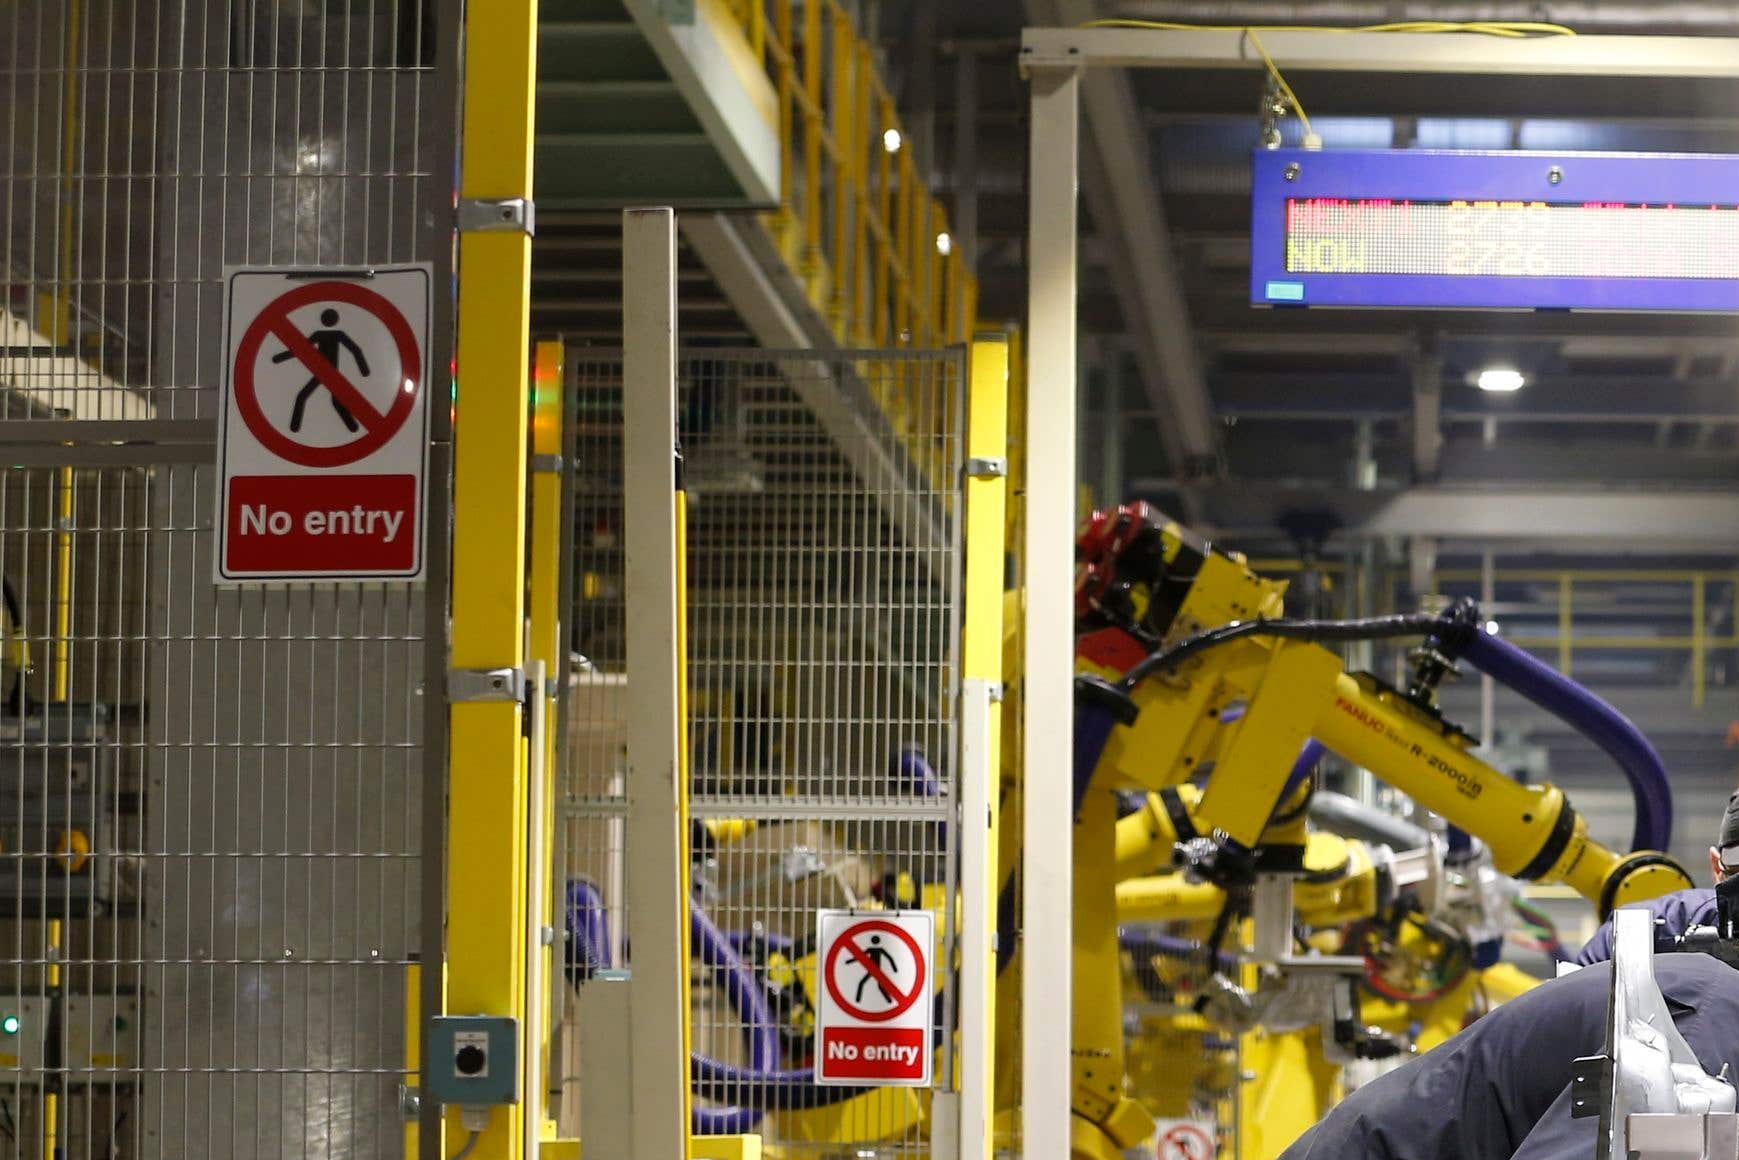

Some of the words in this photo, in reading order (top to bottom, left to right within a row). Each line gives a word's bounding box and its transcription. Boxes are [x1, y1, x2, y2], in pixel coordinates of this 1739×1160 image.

[1286, 238, 1365, 274] NOW
[239, 504, 292, 535] No
[303, 505, 404, 543] entry
[1335, 696, 1385, 734] FANUC
[827, 1041, 858, 1061] No
[863, 1043, 919, 1067] entry
